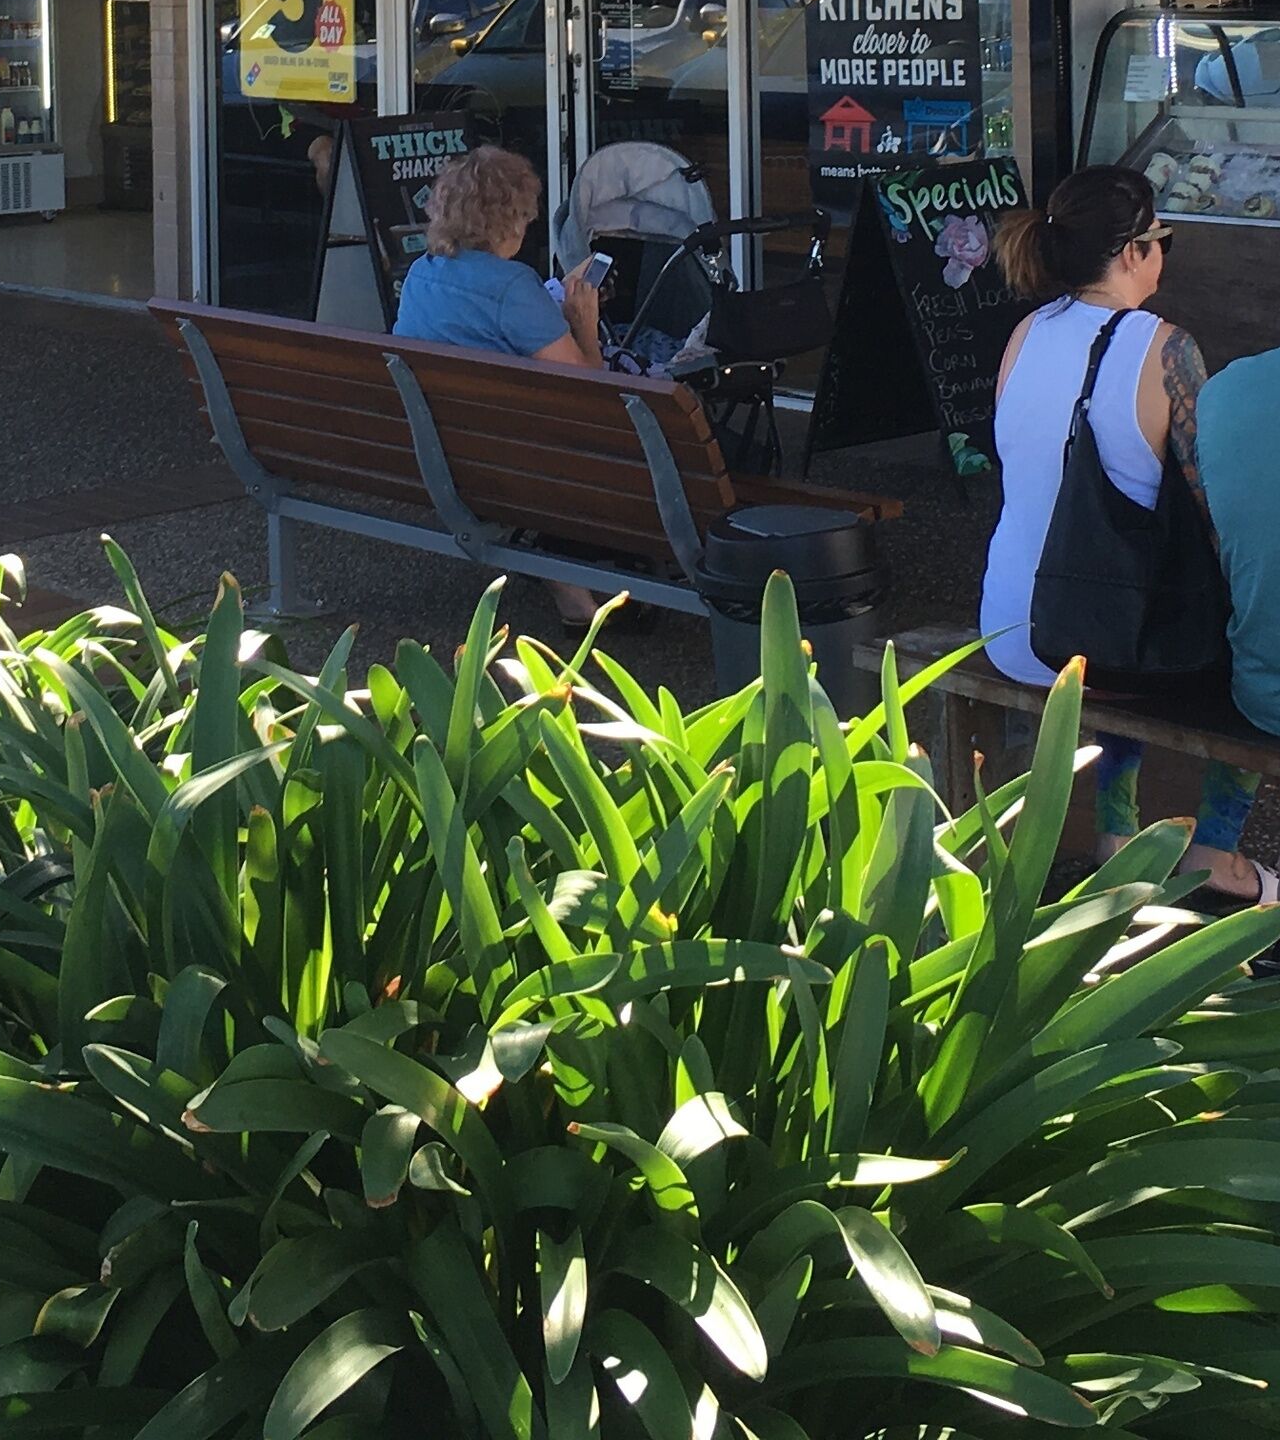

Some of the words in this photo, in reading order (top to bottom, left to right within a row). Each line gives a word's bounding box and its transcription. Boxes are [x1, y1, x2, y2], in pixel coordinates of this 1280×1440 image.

[320, 6, 340, 23] ALL
[320, 26, 343, 44] DAY
[852, 24, 908, 55] closer
[911, 27, 933, 55] to
[820, 58, 878, 86] MORE
[883, 59, 966, 87] PEOPLE
[371, 128, 469, 160] THICK
[821, 164, 856, 177] means
[886, 163, 1019, 242] Specials
